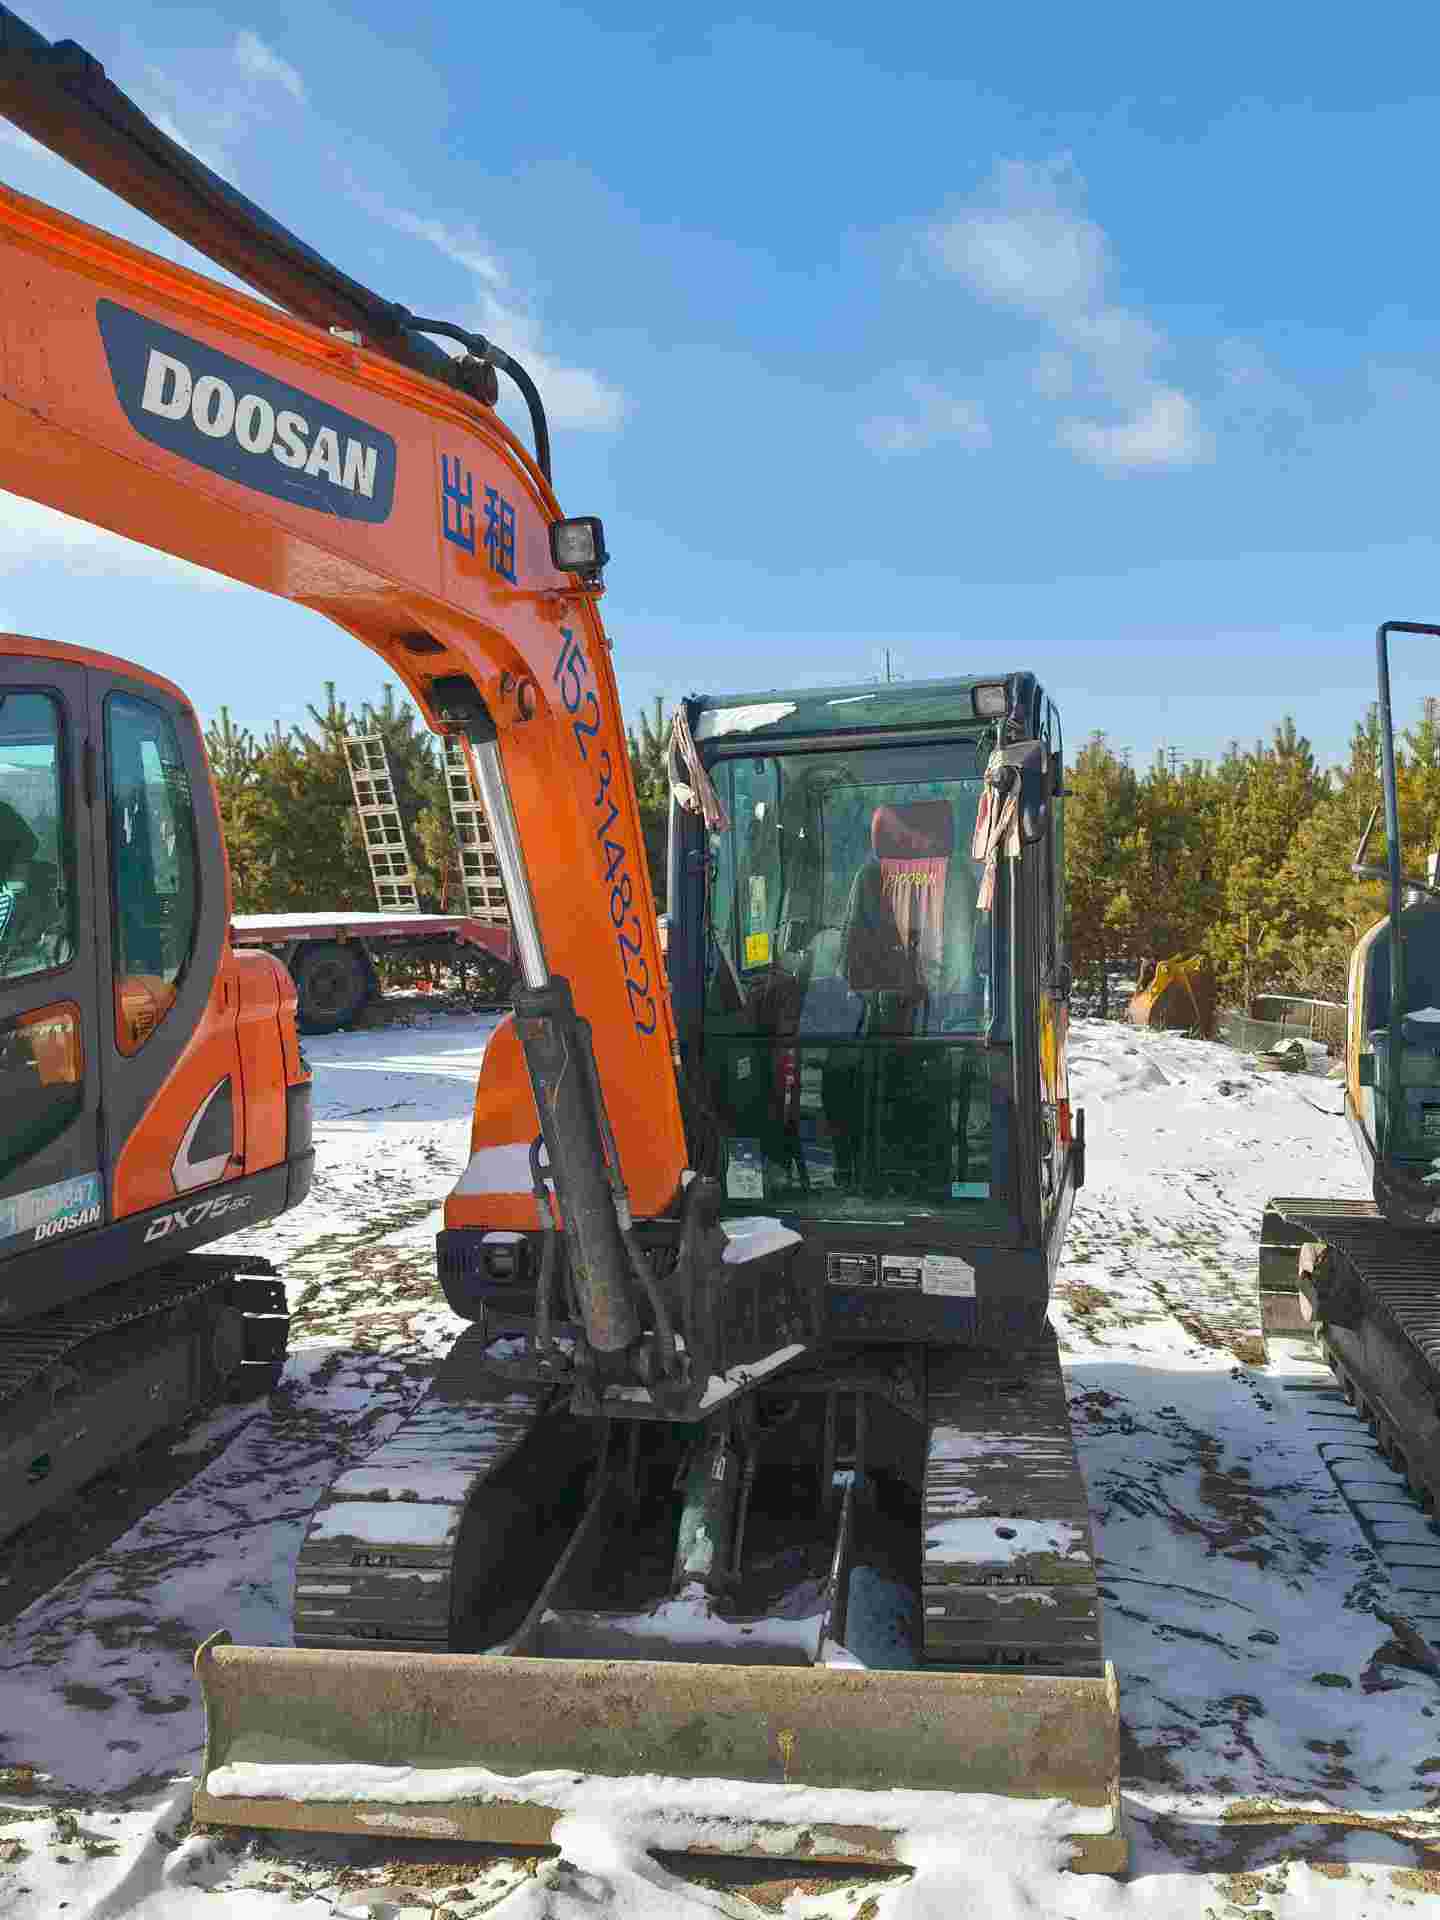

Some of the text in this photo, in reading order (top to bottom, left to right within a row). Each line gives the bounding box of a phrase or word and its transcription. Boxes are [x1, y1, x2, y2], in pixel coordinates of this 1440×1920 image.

[142, 349, 378, 499] DOOSAN
[442, 454, 518, 586] 出租
[34, 1205, 101, 1241] DOOSAN
